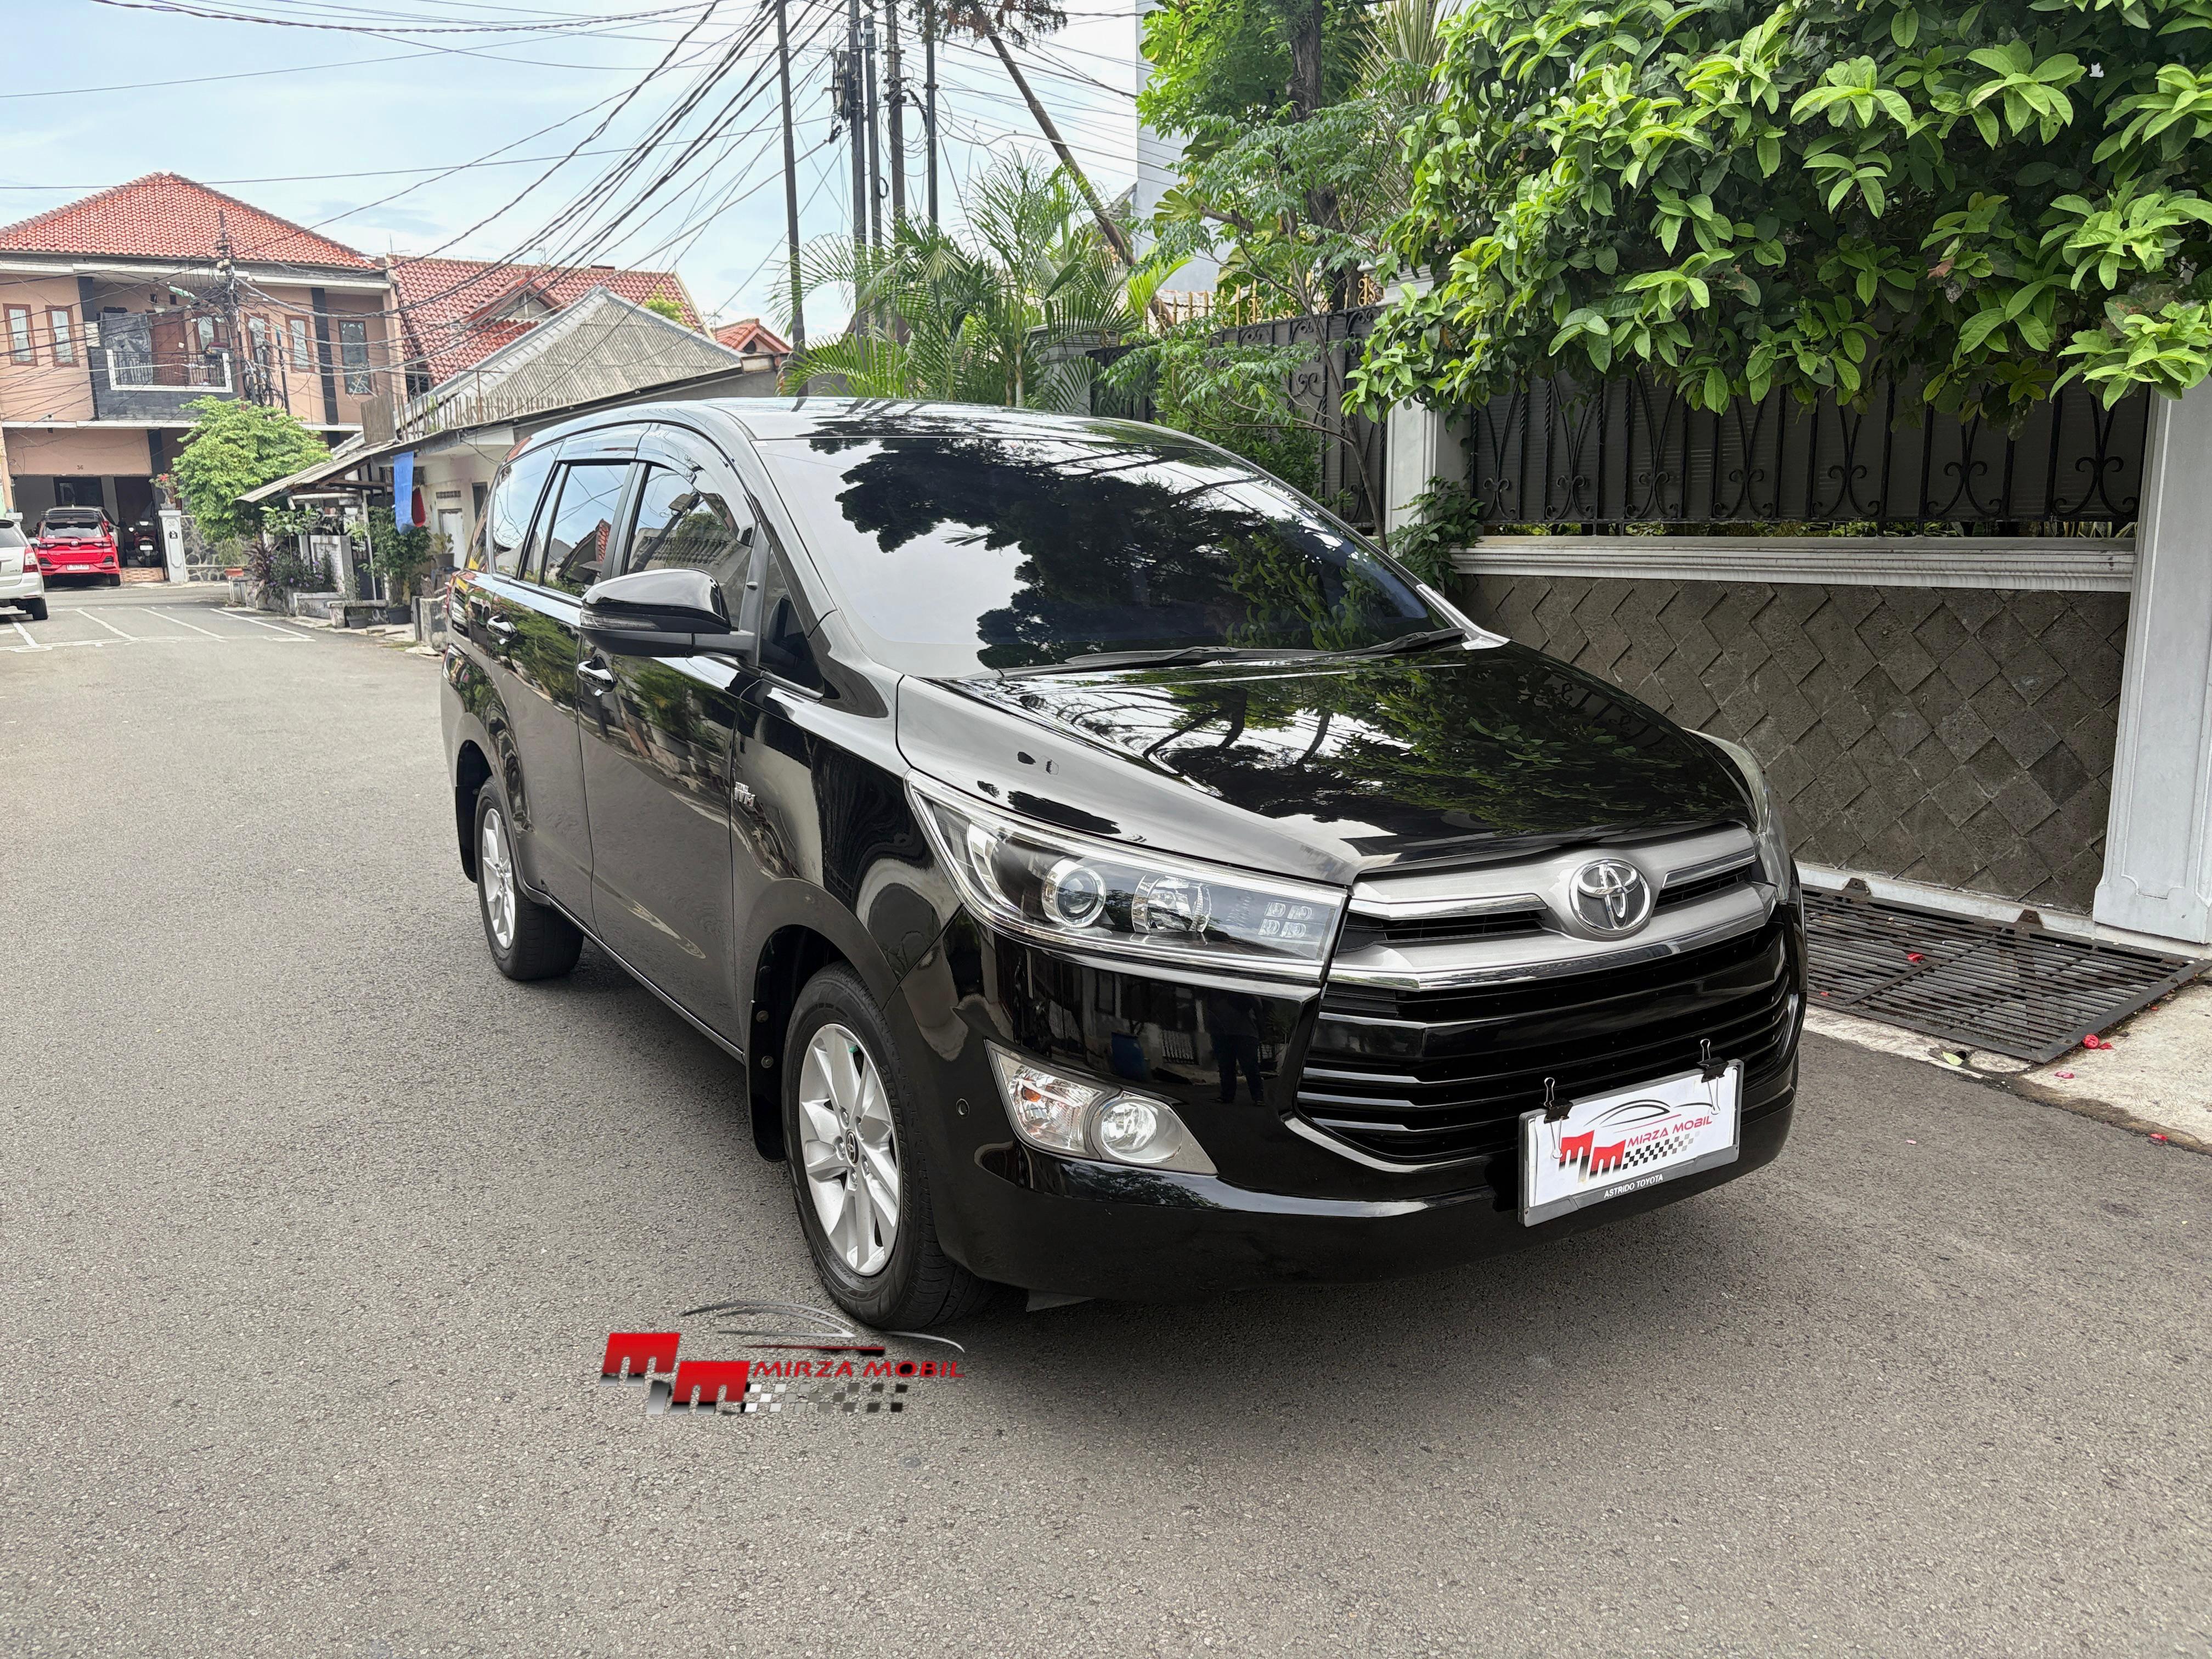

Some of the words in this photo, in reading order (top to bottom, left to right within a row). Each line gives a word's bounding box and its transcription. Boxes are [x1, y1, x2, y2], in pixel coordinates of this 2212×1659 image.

[1627, 1127, 1668, 1148] MIRZA
[1672, 1115, 1713, 1135] MOBIL
[1604, 1183, 1635, 1199] ASTRIDO
[1636, 1173, 1663, 1188] TOYOTA
